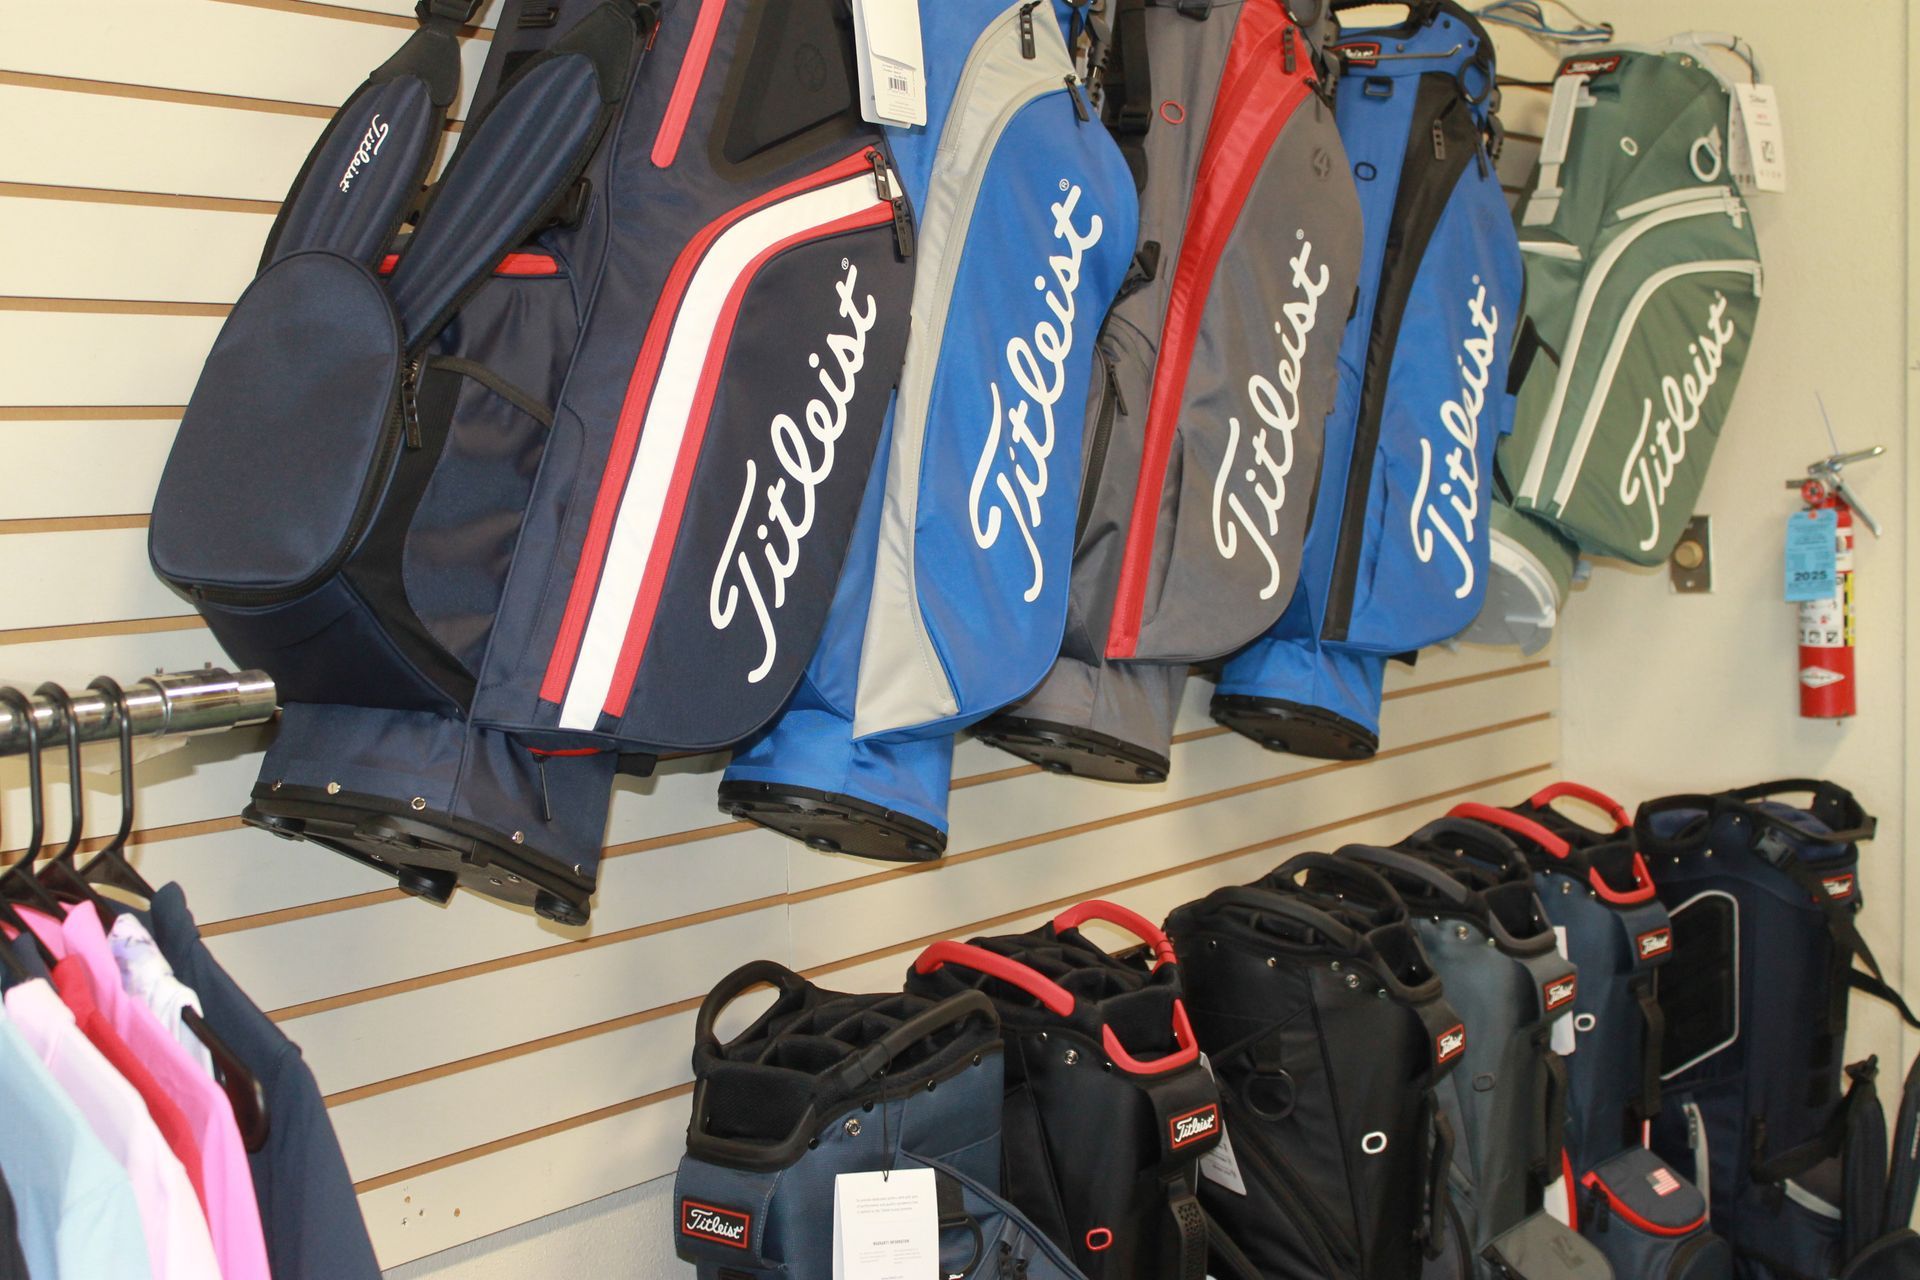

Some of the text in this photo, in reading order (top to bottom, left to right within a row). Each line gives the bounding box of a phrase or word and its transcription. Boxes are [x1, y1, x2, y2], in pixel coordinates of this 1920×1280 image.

[339, 113, 389, 193] Titleist
[709, 264, 877, 684] Titleist
[968, 185, 1103, 603] Titleist
[1212, 241, 1330, 600] Titleist
[1410, 285, 1498, 599] Titleist
[1619, 297, 1734, 551] Titleist
[1794, 570, 1827, 582] 2025
[686, 1208, 744, 1240] Titleist
[1174, 1114, 1215, 1143] Titleist
